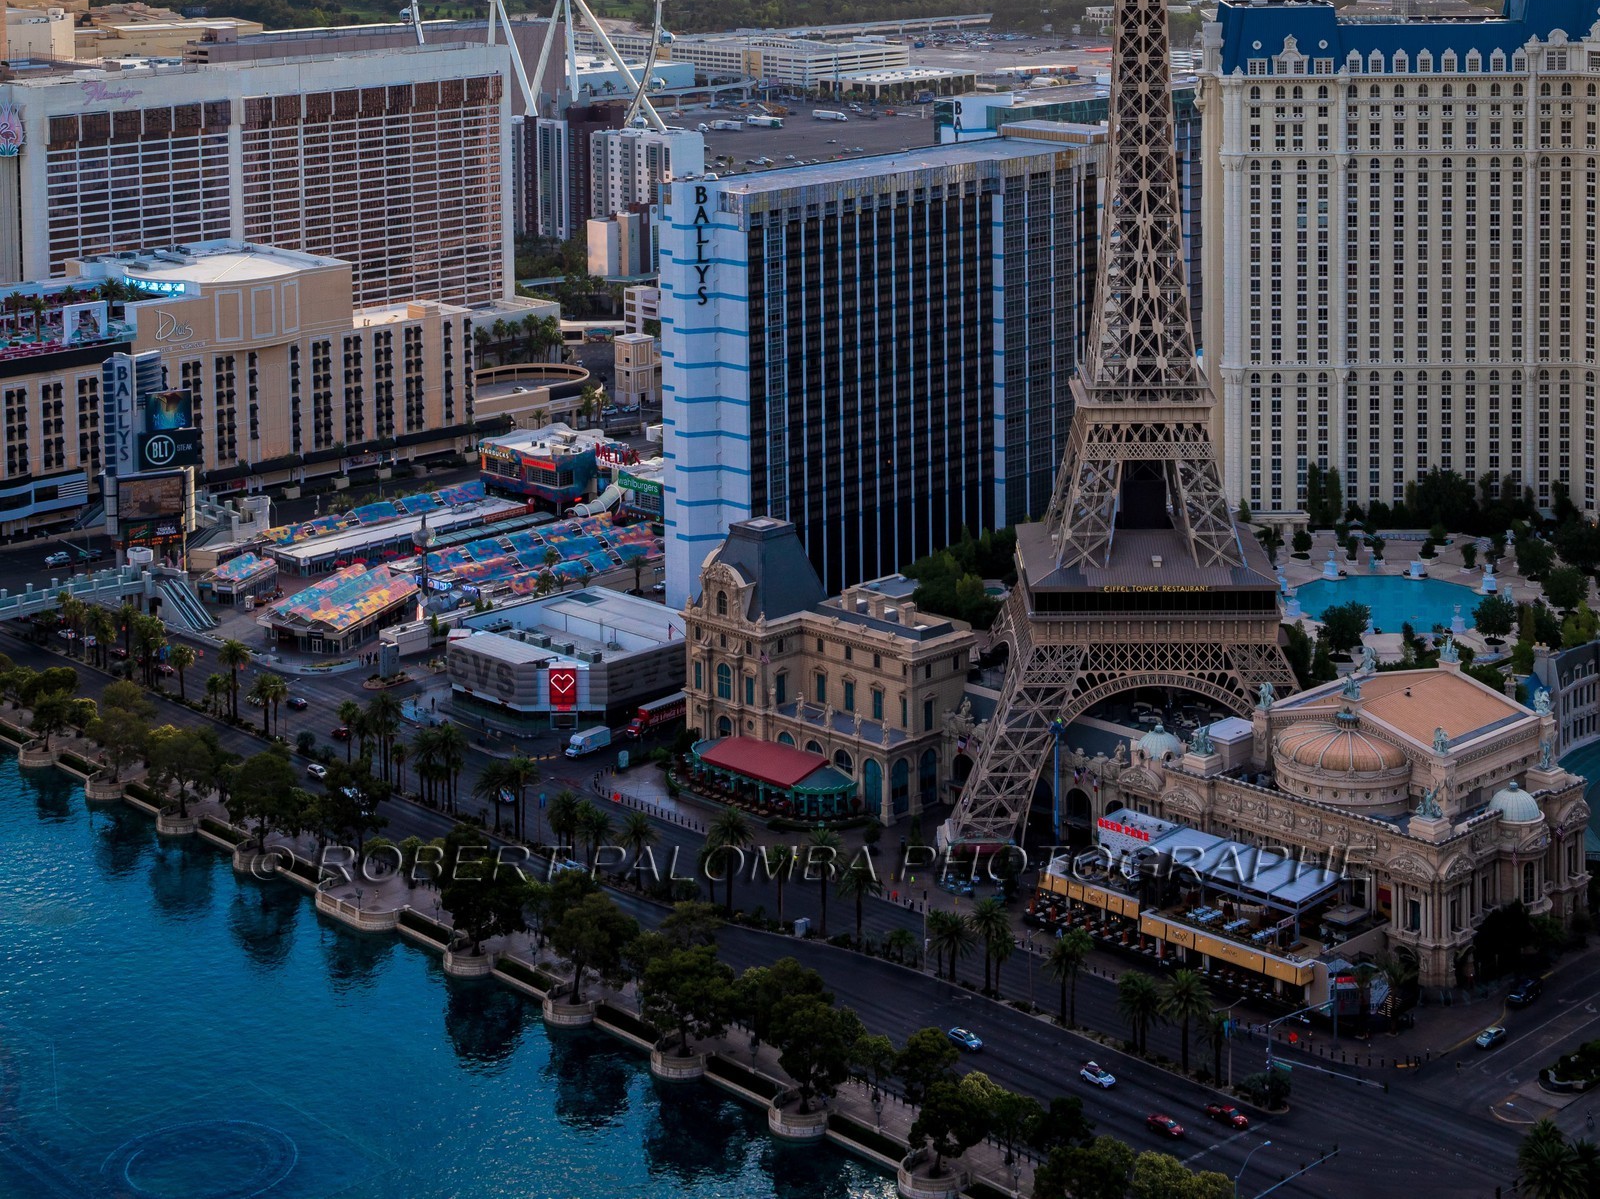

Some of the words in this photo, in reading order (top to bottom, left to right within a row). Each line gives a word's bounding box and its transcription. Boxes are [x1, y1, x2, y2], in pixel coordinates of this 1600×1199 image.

[81, 81, 142, 105] Flamingo
[152, 441, 169, 459] BLT
[177, 443, 193, 452] STEAK
[478, 447, 510, 459] STARBUCKS
[449, 648, 515, 698] CVS
[1098, 818, 1122, 833] BEER
[1125, 827, 1150, 842] PARK
